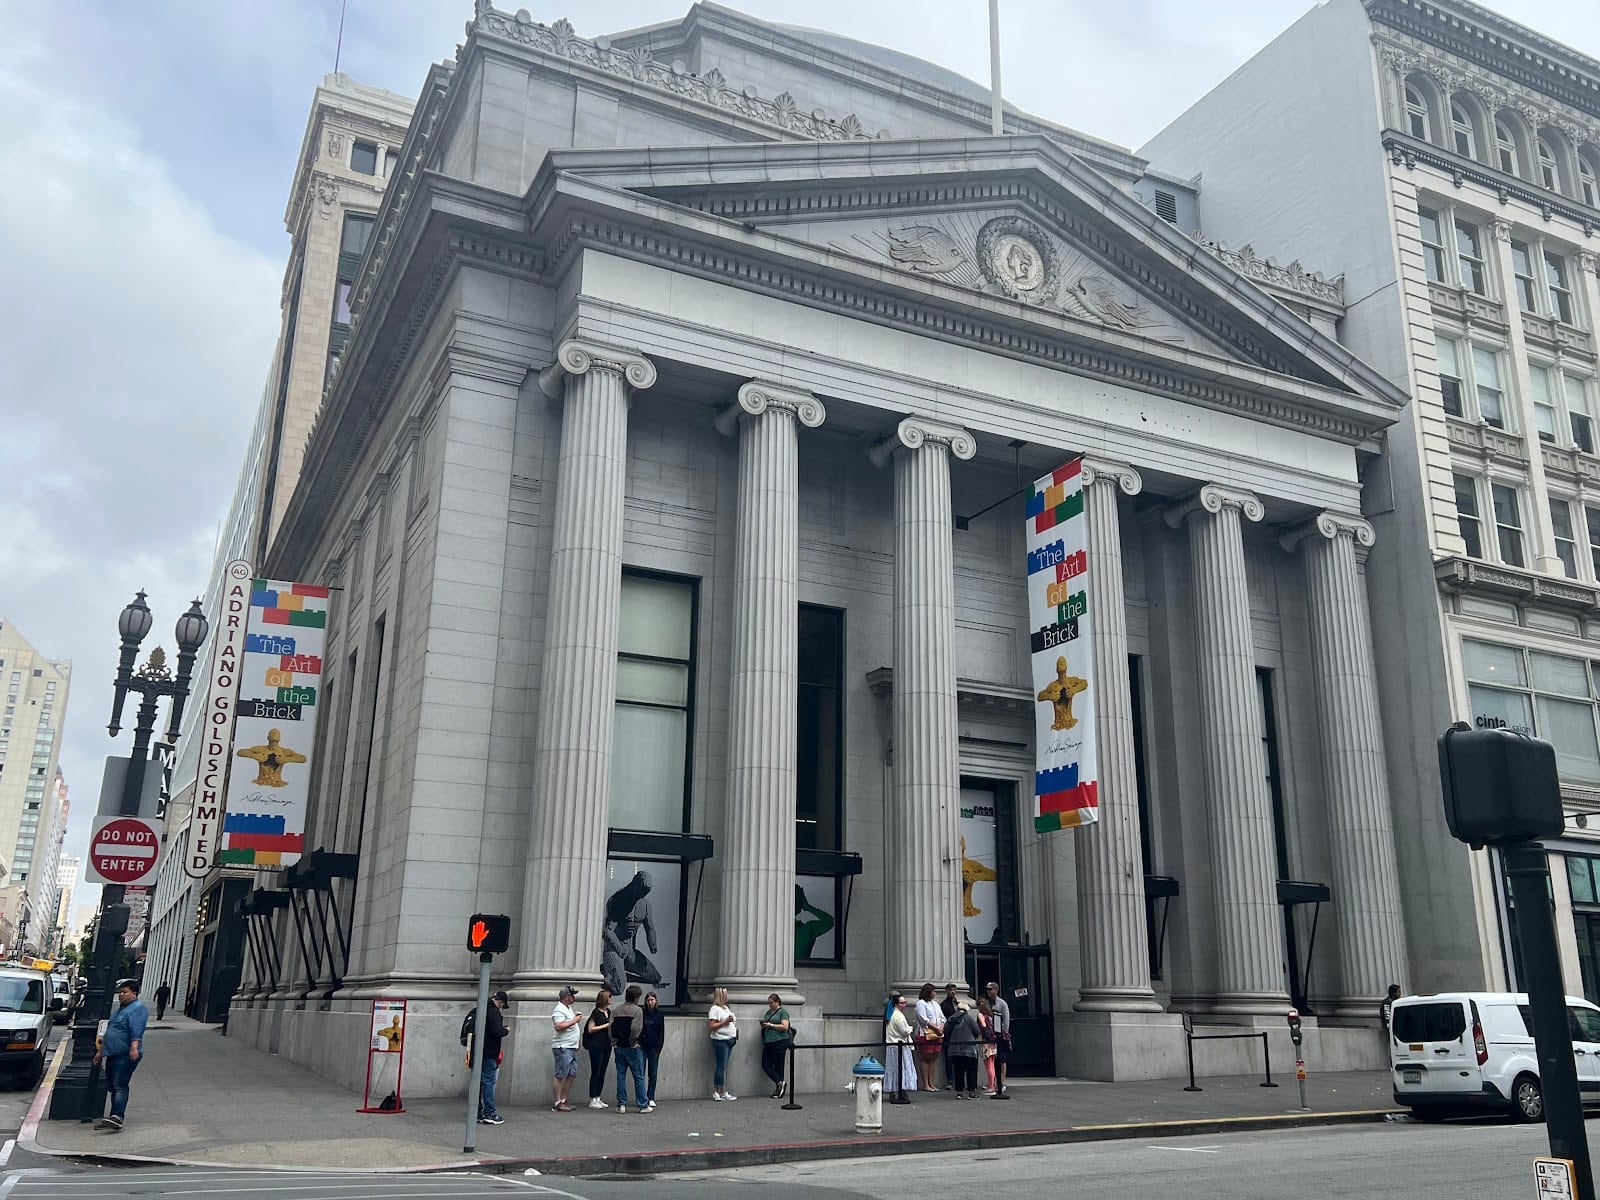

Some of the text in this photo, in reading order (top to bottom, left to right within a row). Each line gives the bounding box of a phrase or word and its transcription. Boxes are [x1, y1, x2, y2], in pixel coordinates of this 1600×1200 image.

[1036, 549, 1063, 570] The
[233, 568, 246, 576] AG
[1061, 559, 1080, 581] Art
[1050, 585, 1064, 605] of
[1062, 601, 1083, 621] the
[217, 585, 244, 688] ADRIANO
[1043, 623, 1076, 649] Brick
[259, 639, 292, 655] The
[286, 658, 313, 673] Art
[270, 673, 287, 686] of
[283, 689, 310, 704] the
[254, 702, 297, 719] Brick
[1476, 713, 1506, 729] cinta
[192, 696, 229, 869] GOLDSCHMIED
[102, 829, 153, 843] DO NOT
[100, 858, 145, 871] ENTER
